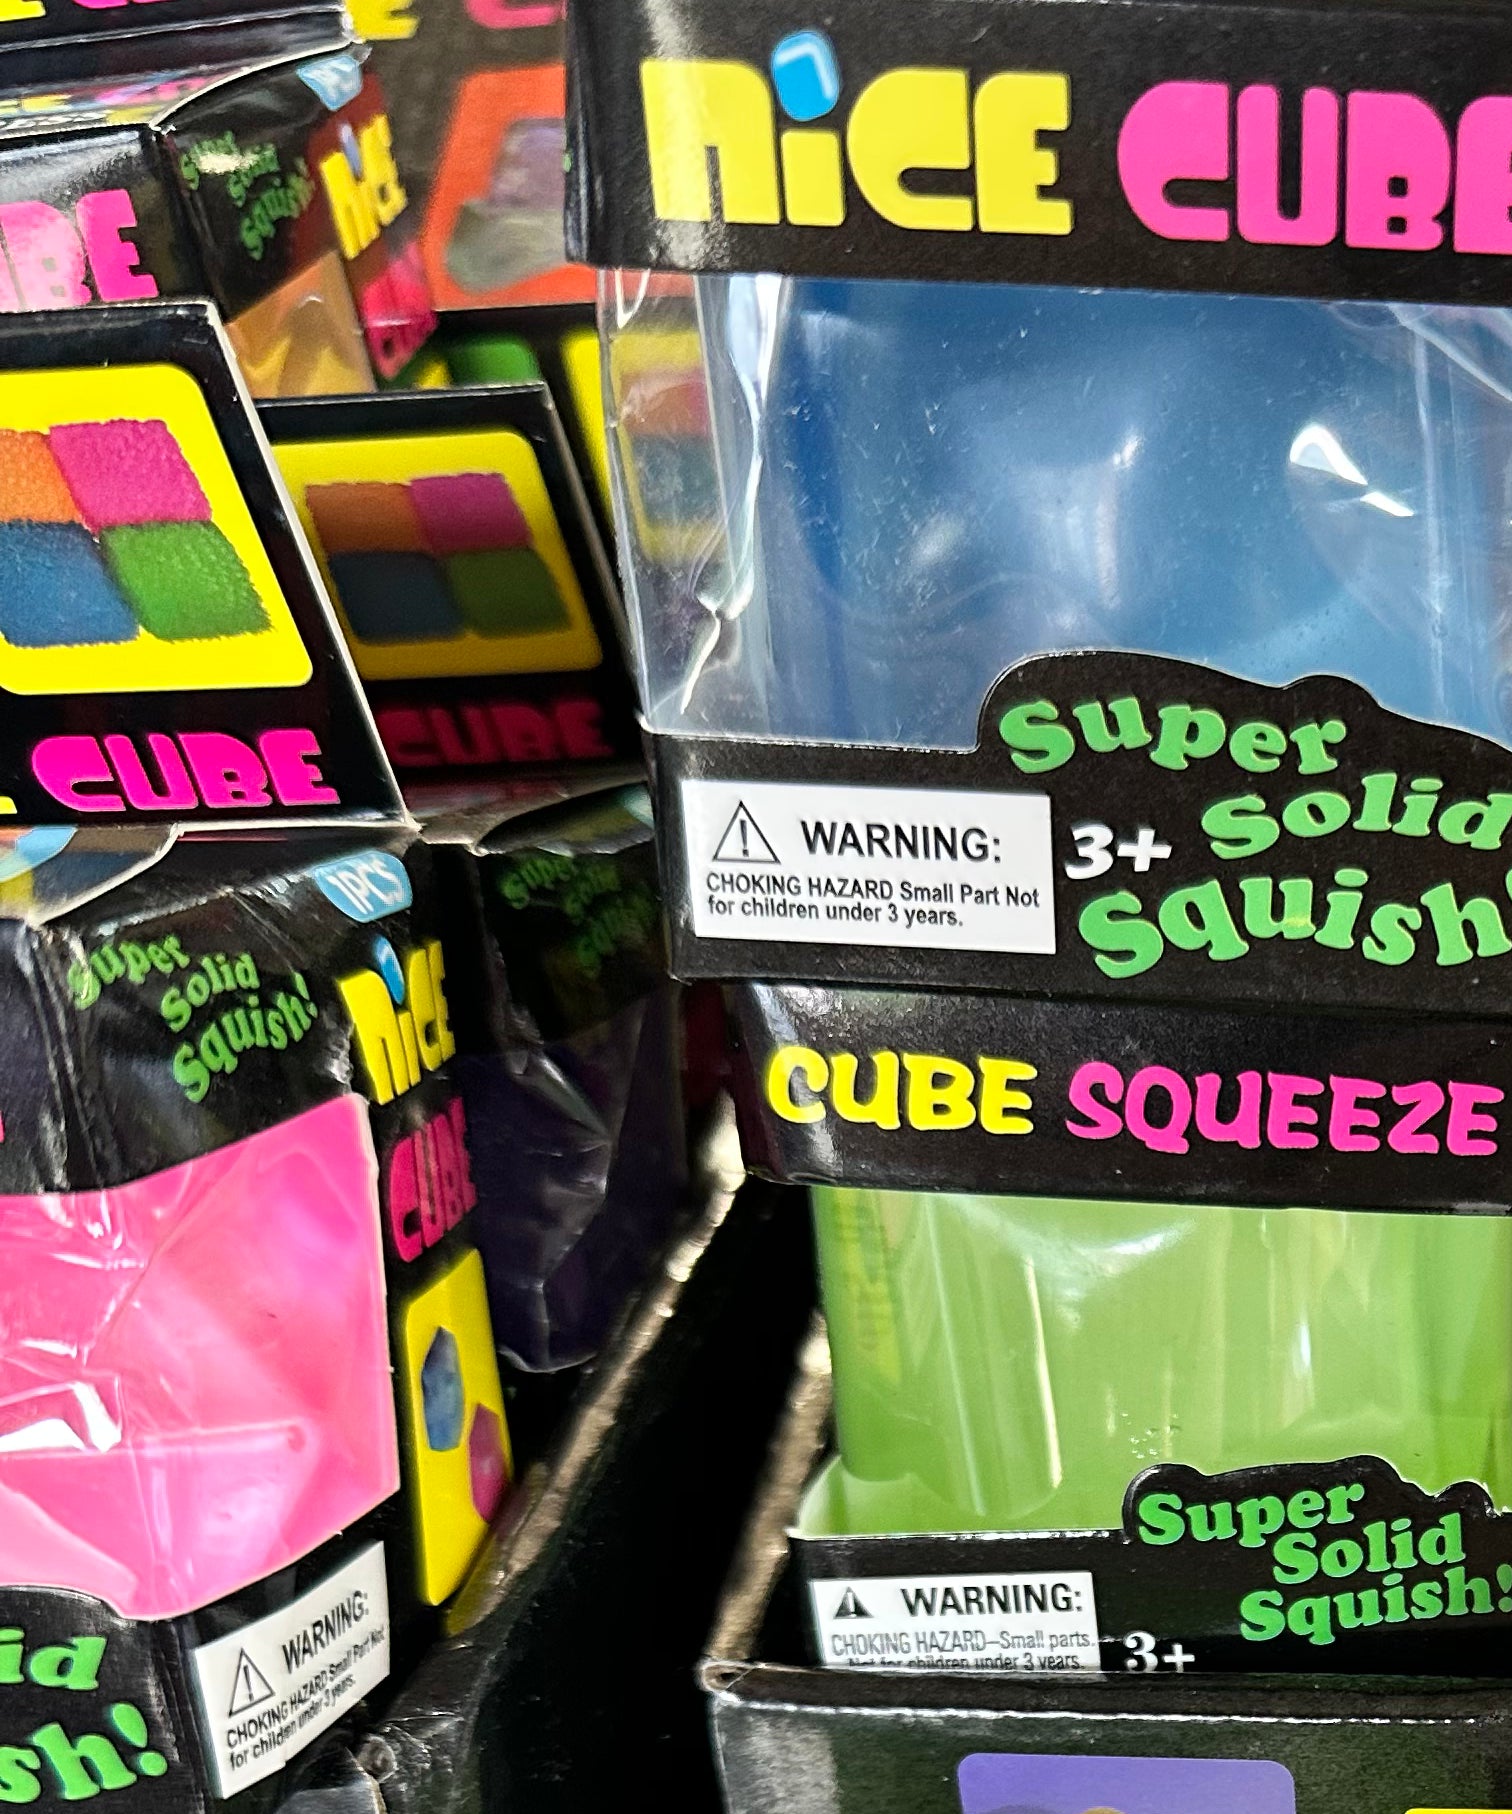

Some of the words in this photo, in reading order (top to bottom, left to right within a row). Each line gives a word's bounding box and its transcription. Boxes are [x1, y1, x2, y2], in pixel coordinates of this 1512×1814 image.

[998, 694, 1349, 776] Super
[31, 729, 341, 812] CUBE
[800, 819, 1001, 864] WARNING:
[1064, 822, 1174, 880] 3+
[706, 872, 801, 896] CHOKING
[808, 876, 894, 900] HAZARD
[900, 881, 954, 904] Small
[960, 884, 1000, 907] Part
[1006, 886, 1041, 908] Not
[707, 893, 736, 916] for
[741, 896, 820, 919] children
[826, 901, 883, 922] under
[887, 903, 899, 923] 3
[904, 907, 964, 929] years.
[68, 933, 191, 1011] Super
[173, 972, 319, 1103] Squish!
[765, 1045, 1038, 1136] CUBE
[1065, 1059, 1506, 1157] SQUEEZE
[389, 1097, 478, 1263] CUBE
[1137, 1478, 1365, 1549] Super
[1272, 1512, 1468, 1585] Solid
[281, 1589, 370, 1675] WARNING:
[900, 1583, 1083, 1617] WARNING:
[831, 1631, 912, 1657] CHOKING
[1049, 1630, 1098, 1652] parts.
[1123, 1630, 1196, 1674] 3+
[226, 1700, 289, 1749] CHOKING
[229, 1748, 250, 1771] for
